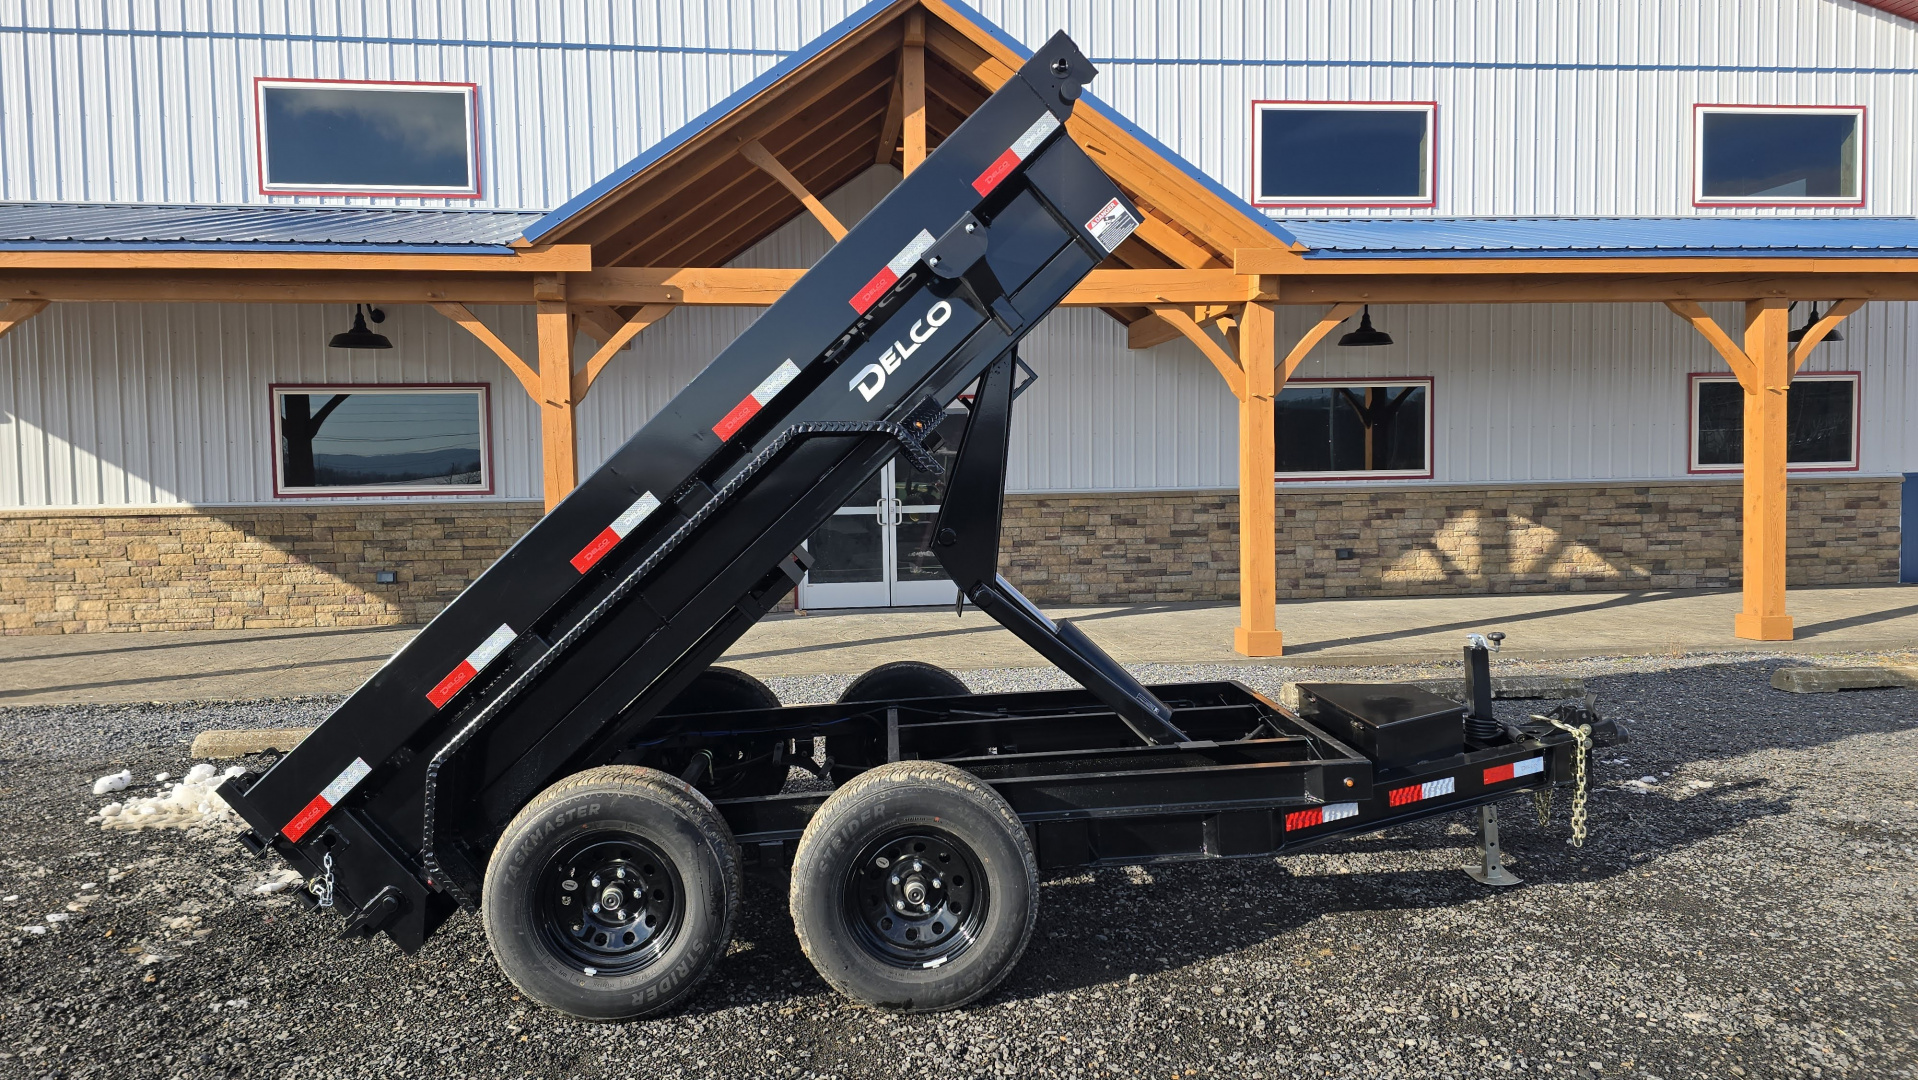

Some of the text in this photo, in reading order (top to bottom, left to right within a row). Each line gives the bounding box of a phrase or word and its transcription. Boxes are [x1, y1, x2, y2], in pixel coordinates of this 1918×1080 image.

[985, 161, 1010, 184] DELCO
[1096, 203, 1116, 222] DANGER
[862, 279, 887, 301] DELCO
[849, 301, 952, 402] DELCO
[584, 538, 610, 561] DELCO
[440, 672, 466, 695] DELCO
[294, 807, 320, 830] DELCO
[503, 803, 601, 888] TASKMASTER
[818, 802, 887, 874] STRIDER
[631, 938, 705, 1007] STRIDER
